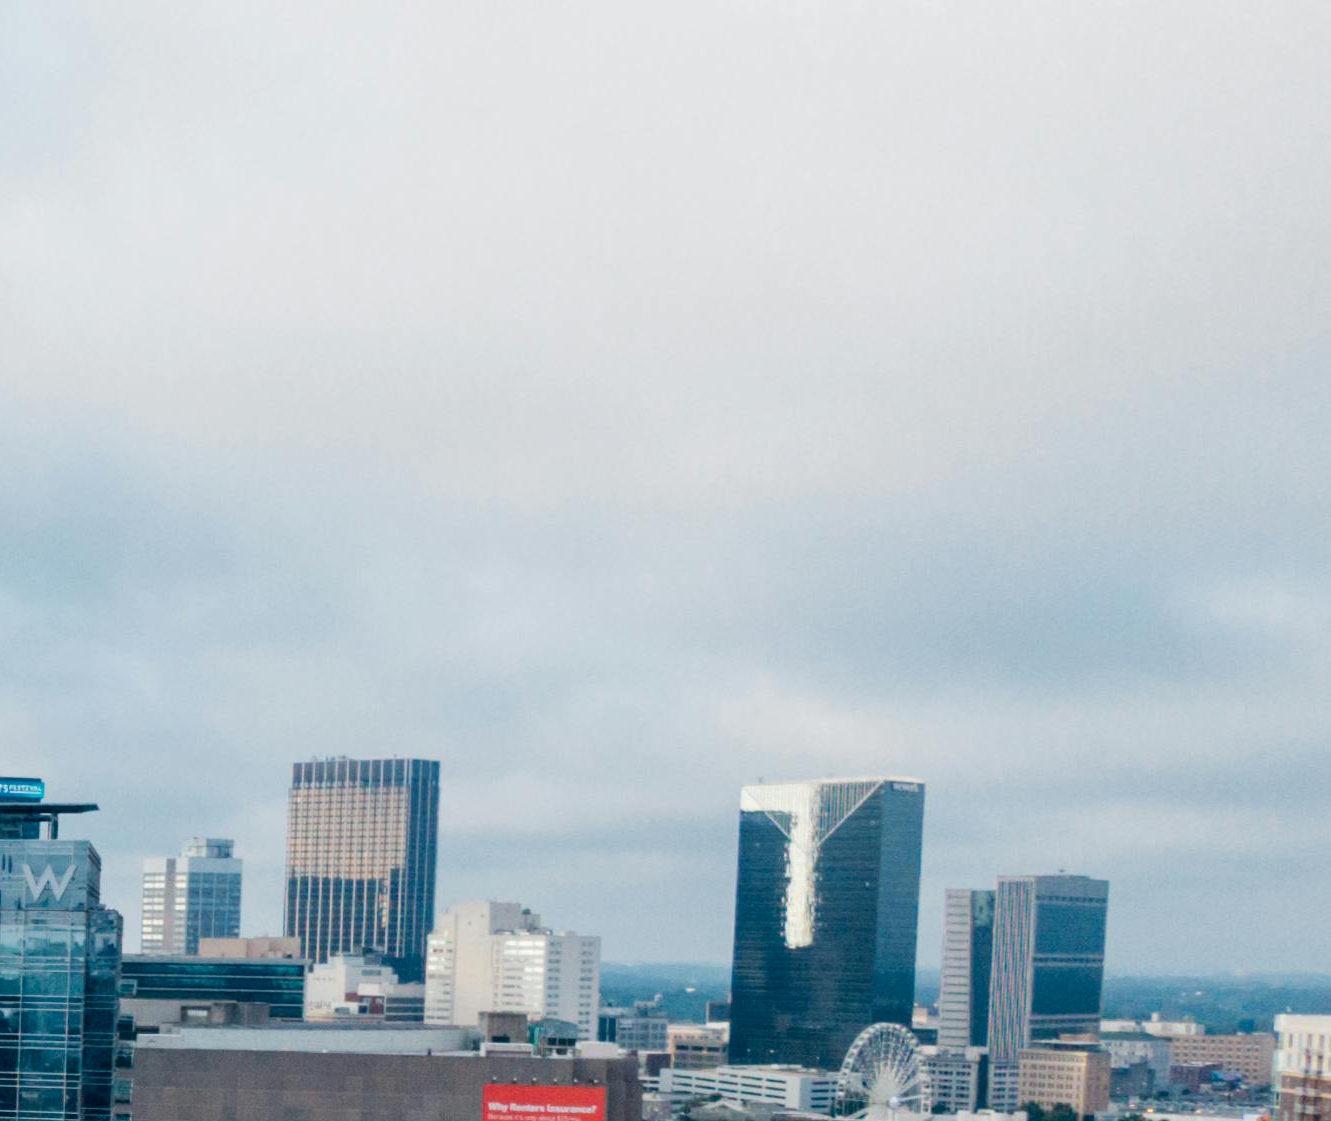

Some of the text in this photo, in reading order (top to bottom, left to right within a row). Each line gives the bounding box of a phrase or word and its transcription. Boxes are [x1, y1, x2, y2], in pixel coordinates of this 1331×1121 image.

[23, 863, 77, 901] W
[487, 1102, 508, 1113] Why
[509, 1103, 545, 1113] Renters
